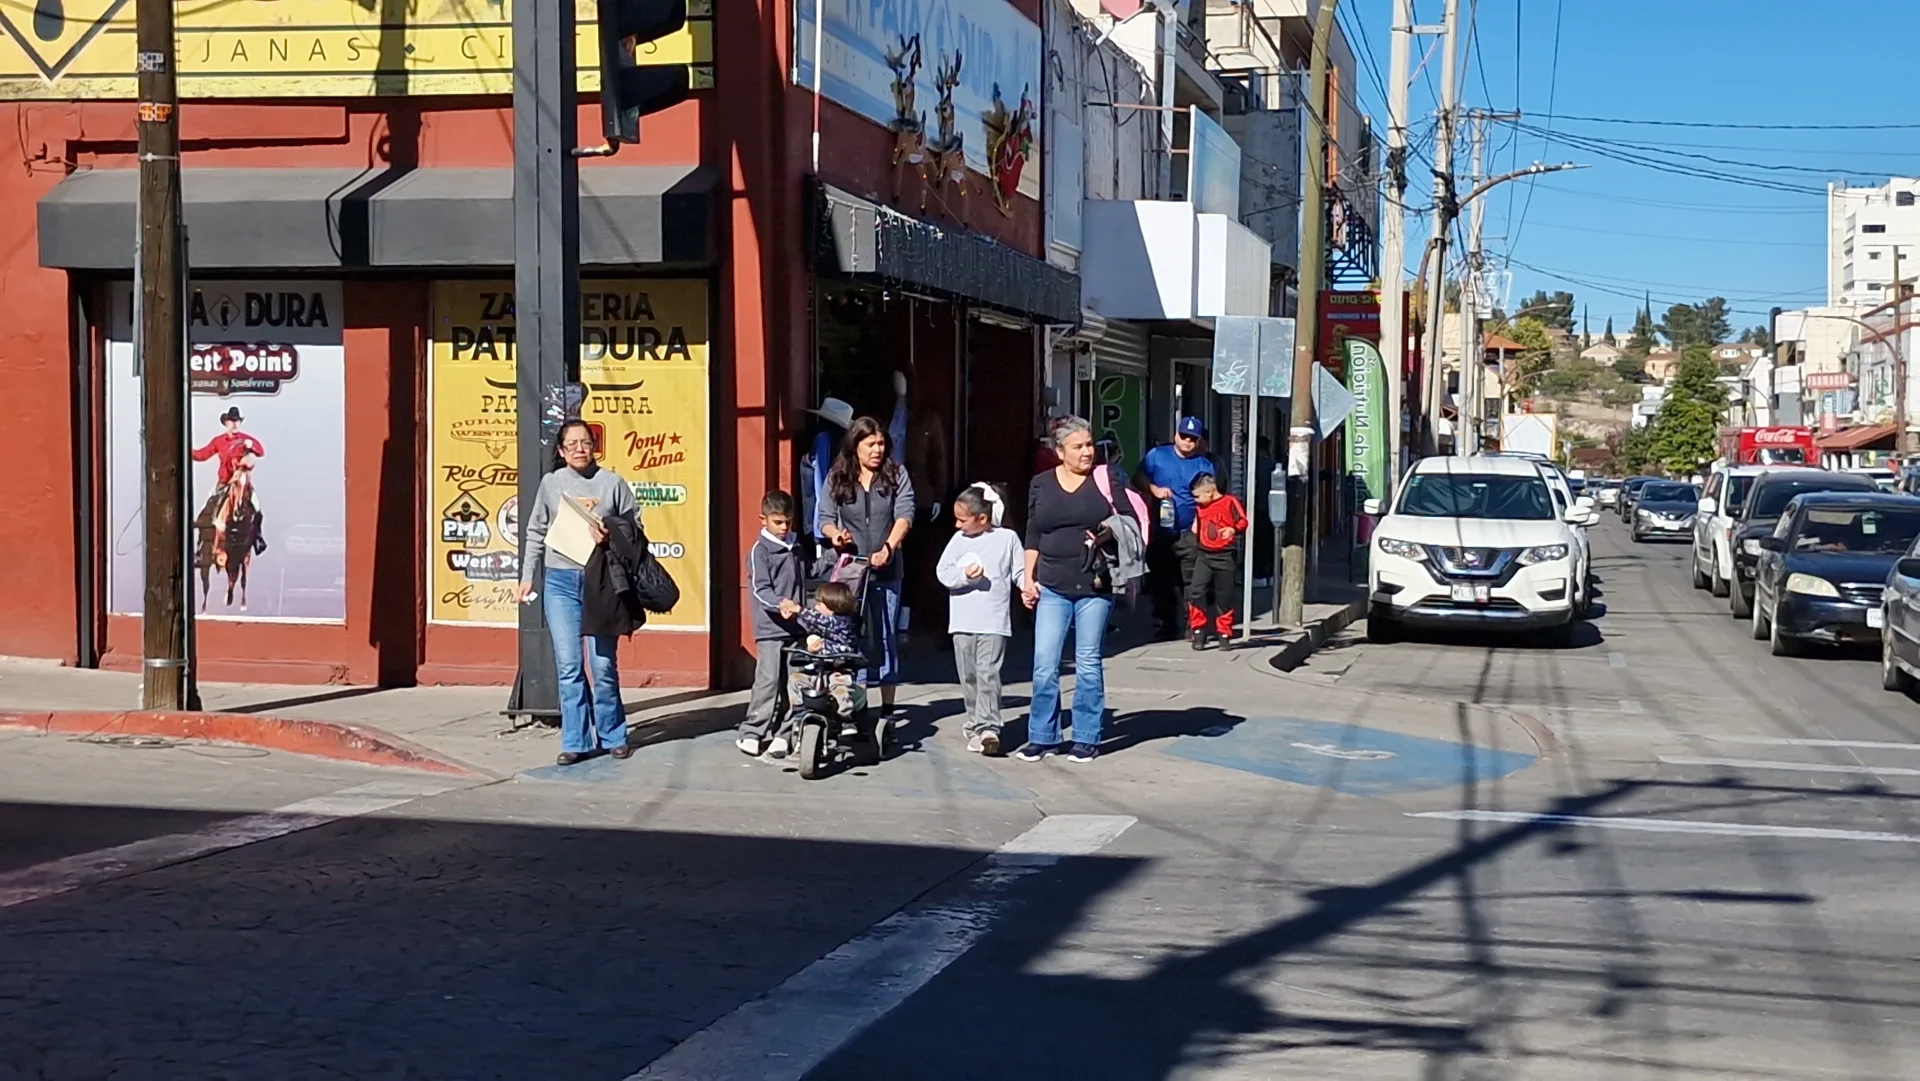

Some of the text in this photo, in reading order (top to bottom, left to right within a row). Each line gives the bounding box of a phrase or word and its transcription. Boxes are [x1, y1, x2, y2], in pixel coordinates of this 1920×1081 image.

[244, 292, 329, 328] DURA
[479, 292, 655, 321] ZAERIA
[451, 326, 693, 361] PAT DURA
[190, 349, 293, 372] est Point
[592, 396, 653, 414] DURA
[451, 418, 516, 429] DURAN
[623, 430, 667, 457] Tony
[633, 448, 686, 471] Lama
[441, 464, 477, 482] Rio
[451, 553, 494, 569] West
[647, 542, 685, 558] NDO
